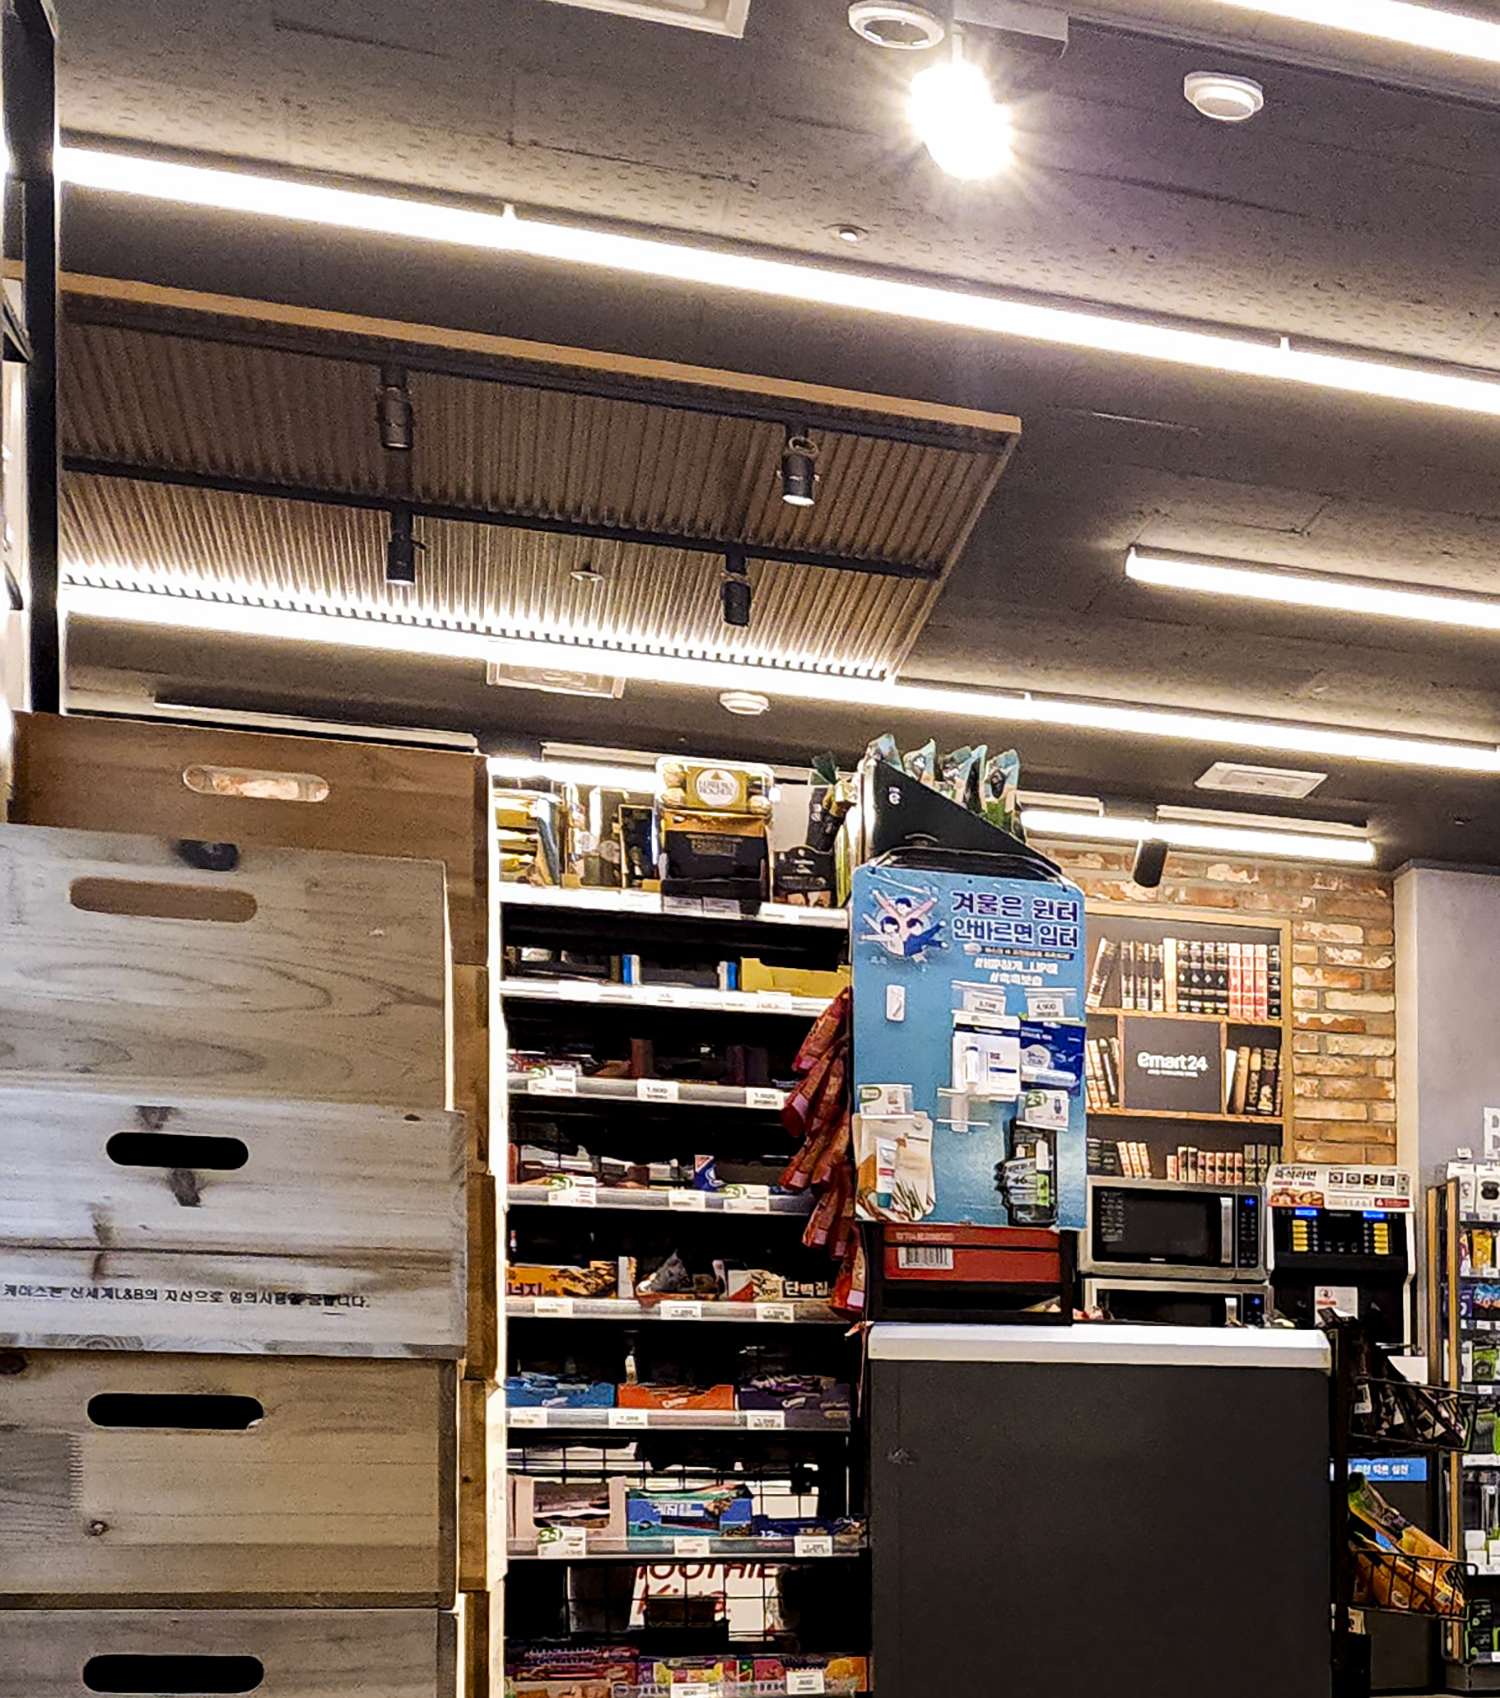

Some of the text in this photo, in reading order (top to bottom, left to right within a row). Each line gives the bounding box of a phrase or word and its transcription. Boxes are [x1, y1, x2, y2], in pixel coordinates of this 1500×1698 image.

[952, 890, 1079, 924] 겨울은 윈터
[952, 917, 1079, 949] 안바르면 입터
[1137, 1051, 1207, 1072] emart24
[70, 1286, 158, 1301] 신세계L&B의
[165, 1288, 223, 1303] 자산으로
[783, 1280, 829, 1298] 단백질
